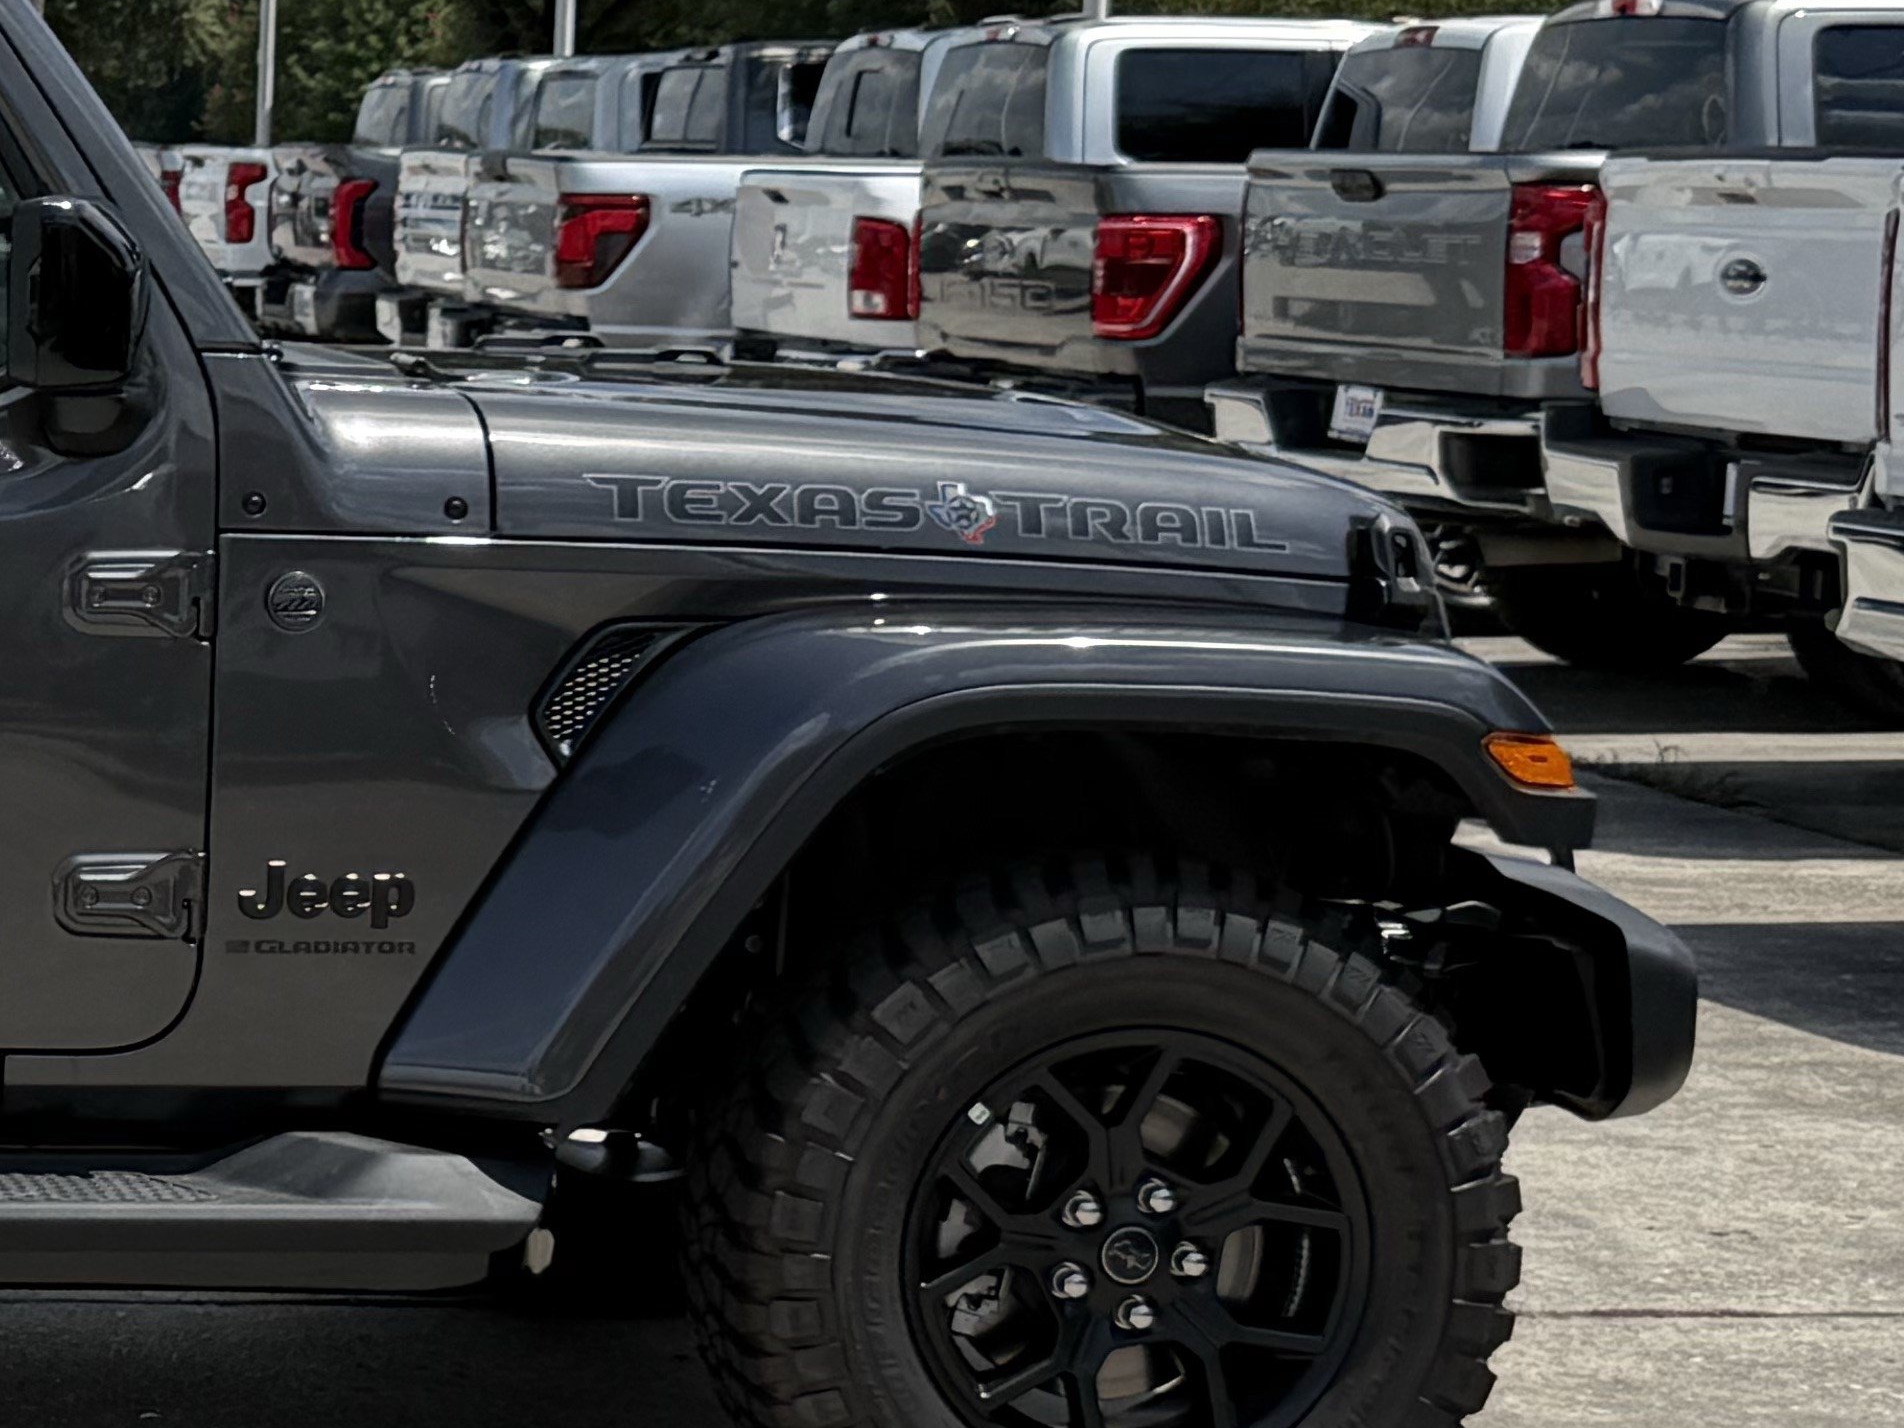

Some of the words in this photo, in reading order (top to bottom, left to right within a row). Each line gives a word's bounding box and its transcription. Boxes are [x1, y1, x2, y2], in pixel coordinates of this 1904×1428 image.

[582, 472, 923, 532] TEXAS
[987, 491, 1292, 552] TRAIL
[237, 859, 415, 930] Jeep
[253, 938, 417, 956] GLADIATOR
